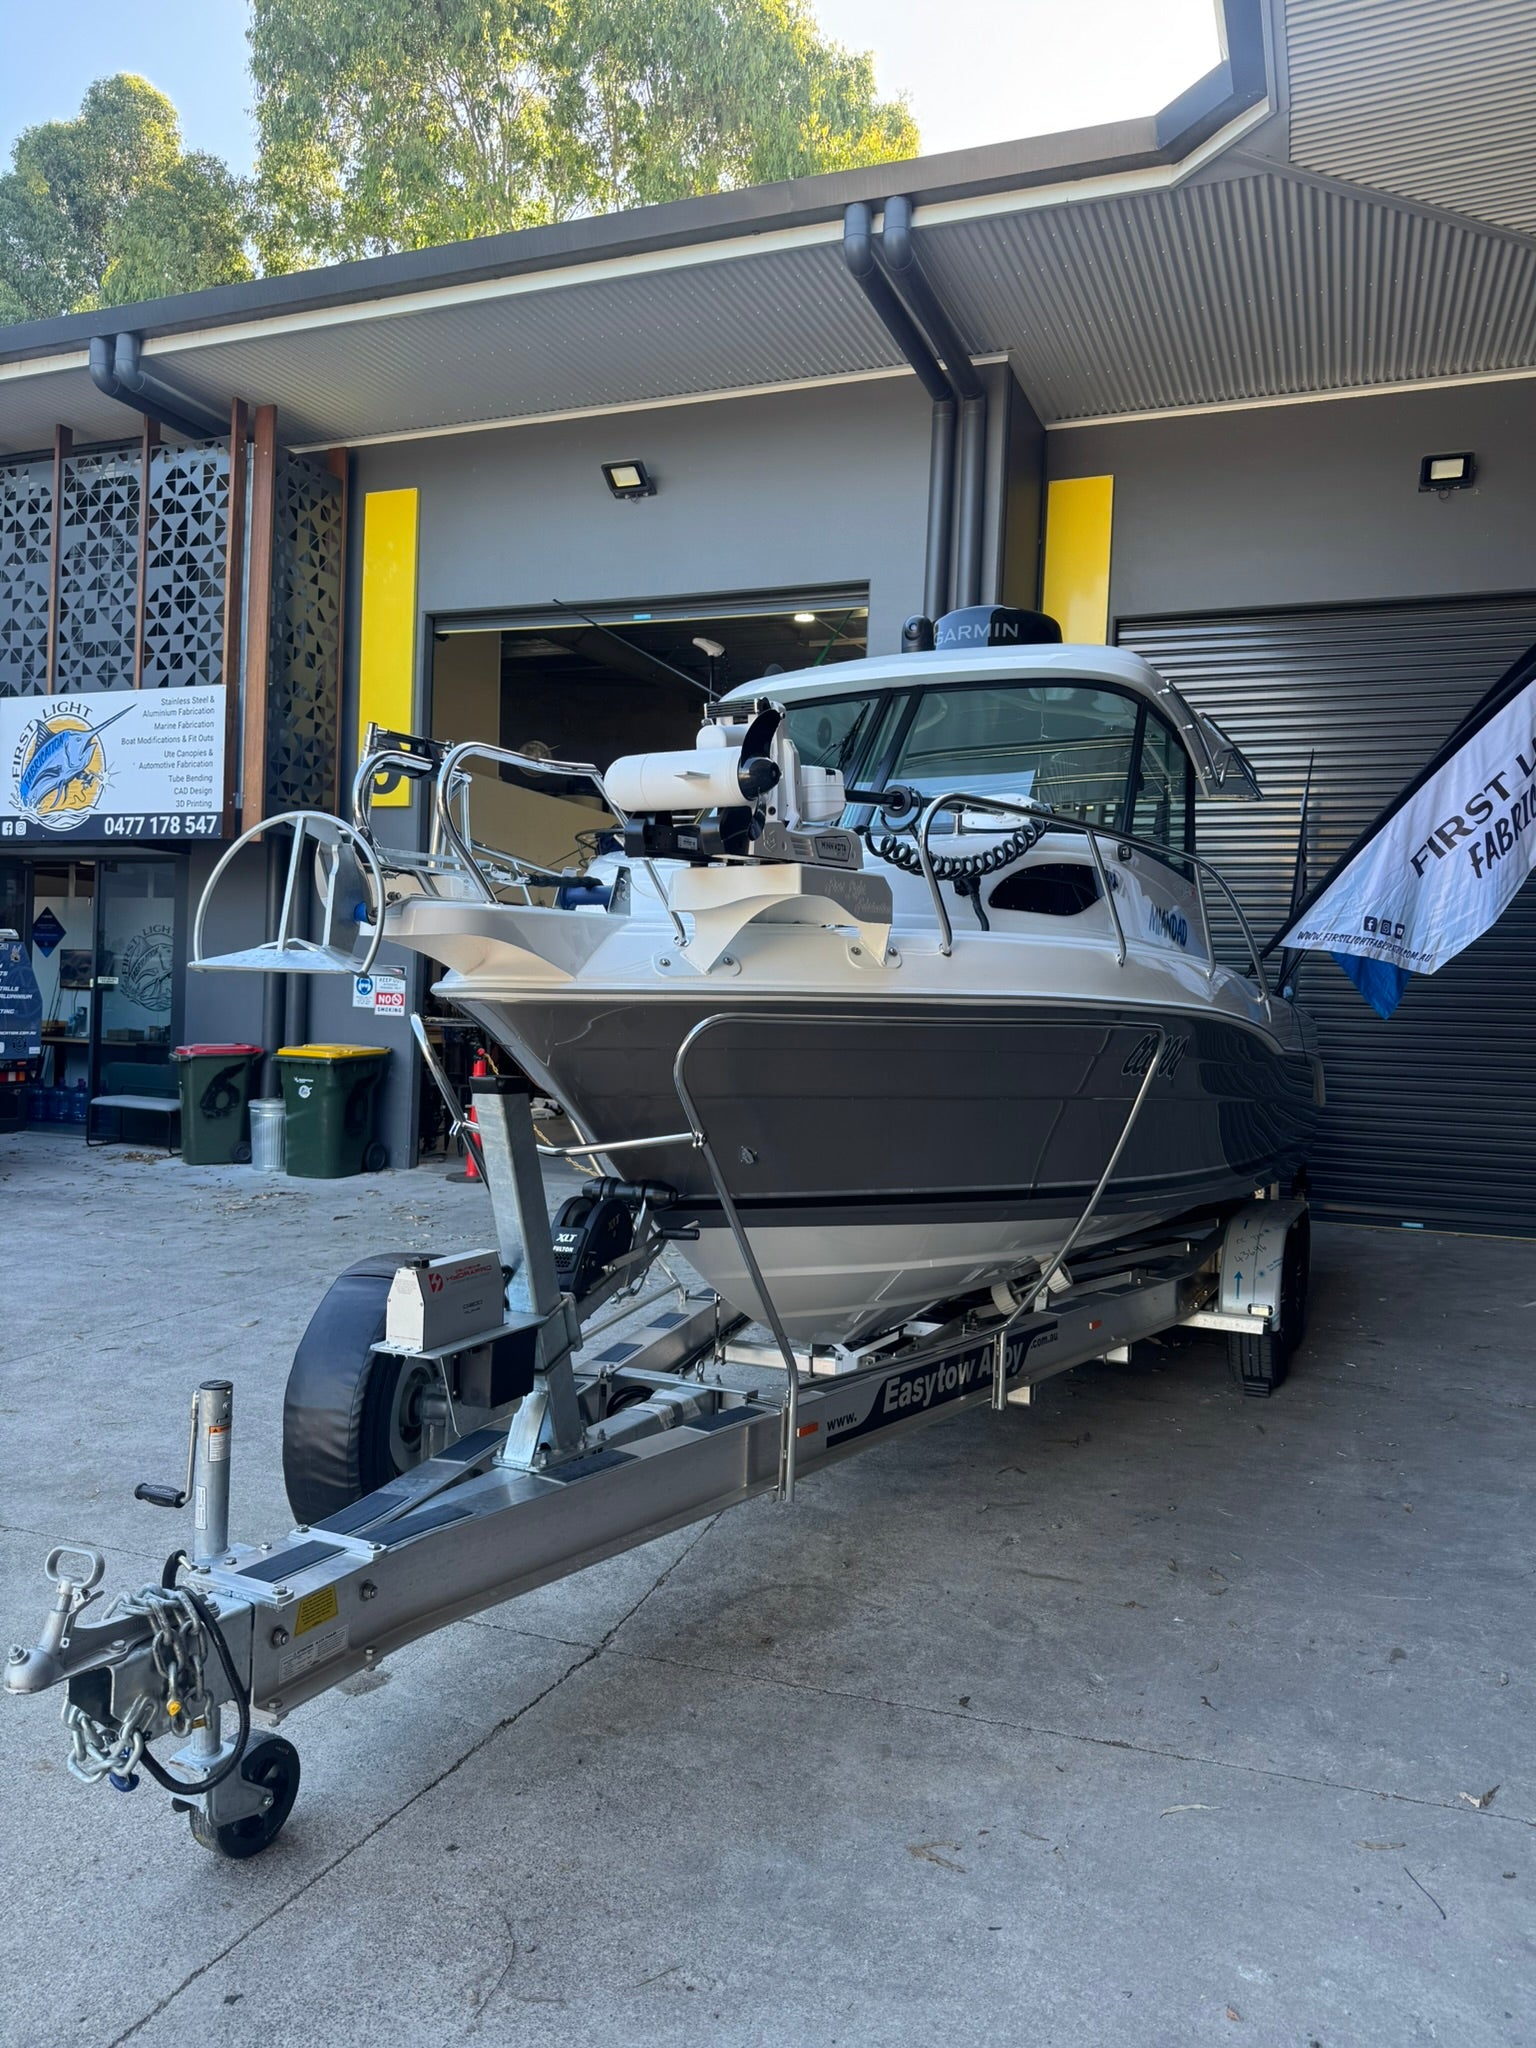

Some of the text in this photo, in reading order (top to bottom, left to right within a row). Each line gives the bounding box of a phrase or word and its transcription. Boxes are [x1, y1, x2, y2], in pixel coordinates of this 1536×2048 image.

[934, 623, 1018, 645] GARMIN
[161, 697, 190, 706] Stainless
[192, 696, 209, 704] Steel
[42, 700, 93, 719] LIGHT
[142, 707, 215, 718] Aluminium Fabrication
[154, 720, 215, 730] Marine Fabrication
[121, 734, 214, 746] Boat Modifications & Fit Outs
[12, 721, 36, 778] FIRST
[164, 748, 213, 758] Ute Canopies &
[23, 731, 66, 787] FABRICATION
[138, 760, 213, 770] Automotive Fabrication
[168, 774, 213, 783] Tube Bending
[174, 787, 212, 796] CAD Design
[176, 799, 212, 808] 3D Printing
[104, 815, 217, 835] 0477 178 547
[1410, 770, 1511, 878] FIRST
[142, 924, 173, 936] LIGH
[378, 994, 391, 1004] NO
[200, 1062, 247, 1119] 6
[556, 1233, 578, 1243] XLT
[552, 1245, 574, 1253] FULTON
[827, 1332, 1059, 1432] www. Easytow Aoy .com.au
[827, 1342, 1024, 1432] www. Easytow Aoy
